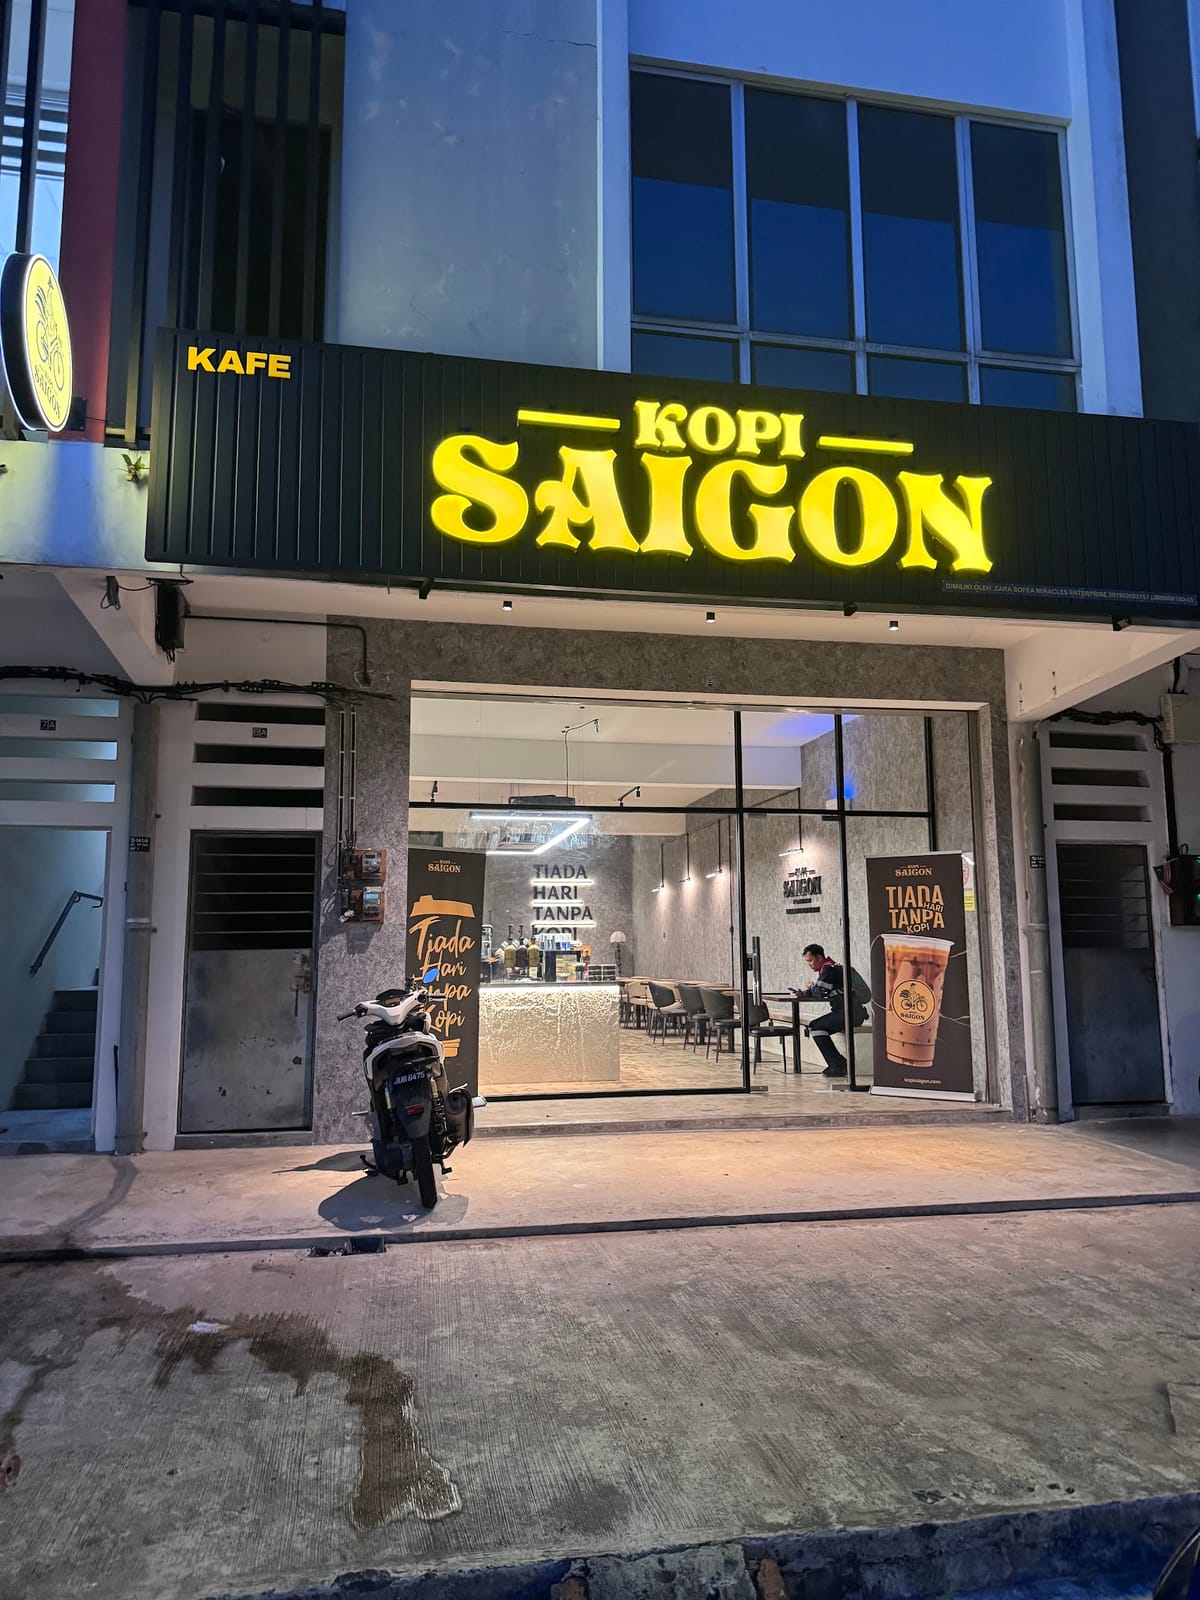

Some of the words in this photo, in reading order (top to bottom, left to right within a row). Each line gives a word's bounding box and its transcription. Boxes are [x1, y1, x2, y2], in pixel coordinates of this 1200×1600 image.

[187, 346, 292, 379] KAFE
[633, 400, 805, 459] KOPI
[431, 434, 993, 574] SAIGON
[1069, 589, 1108, 598] ENTERPRISE
[428, 863, 461, 873] SAIGON
[533, 864, 587, 879] TIADA
[895, 867, 933, 877] SAIGON
[533, 885, 578, 900] HARI
[783, 875, 822, 898] SAIGON
[885, 885, 944, 908] TIADA
[533, 906, 593, 921] TANPA
[923, 902, 944, 913] HARI
[889, 908, 945, 929] TANPA
[906, 922, 930, 934] KOPI
[409, 916, 476, 960] Tiada
